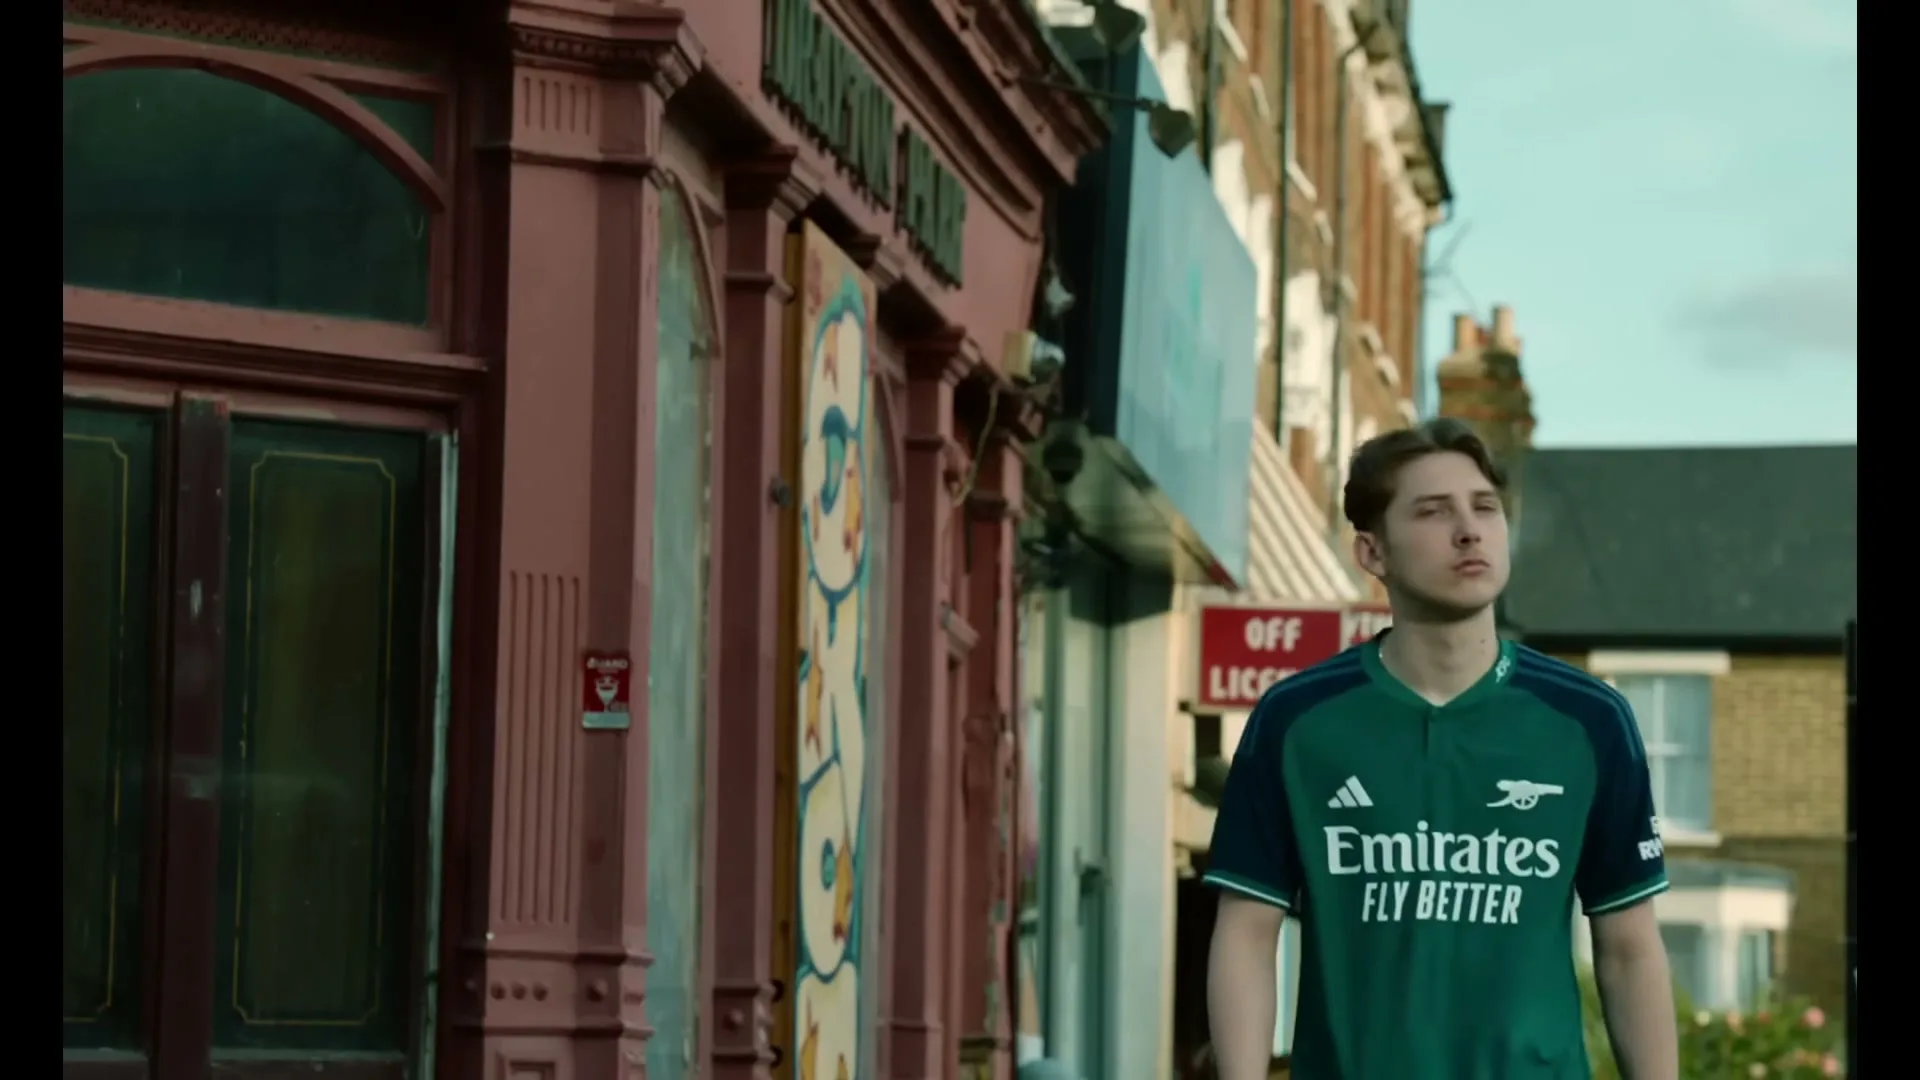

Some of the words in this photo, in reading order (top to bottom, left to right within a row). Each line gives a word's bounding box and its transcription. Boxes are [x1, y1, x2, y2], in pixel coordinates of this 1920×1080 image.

[1244, 616, 1303, 652] OFF
[1323, 820, 1560, 878] Emirates
[1362, 880, 1411, 923] FLY
[1415, 880, 1523, 925] BETTER
